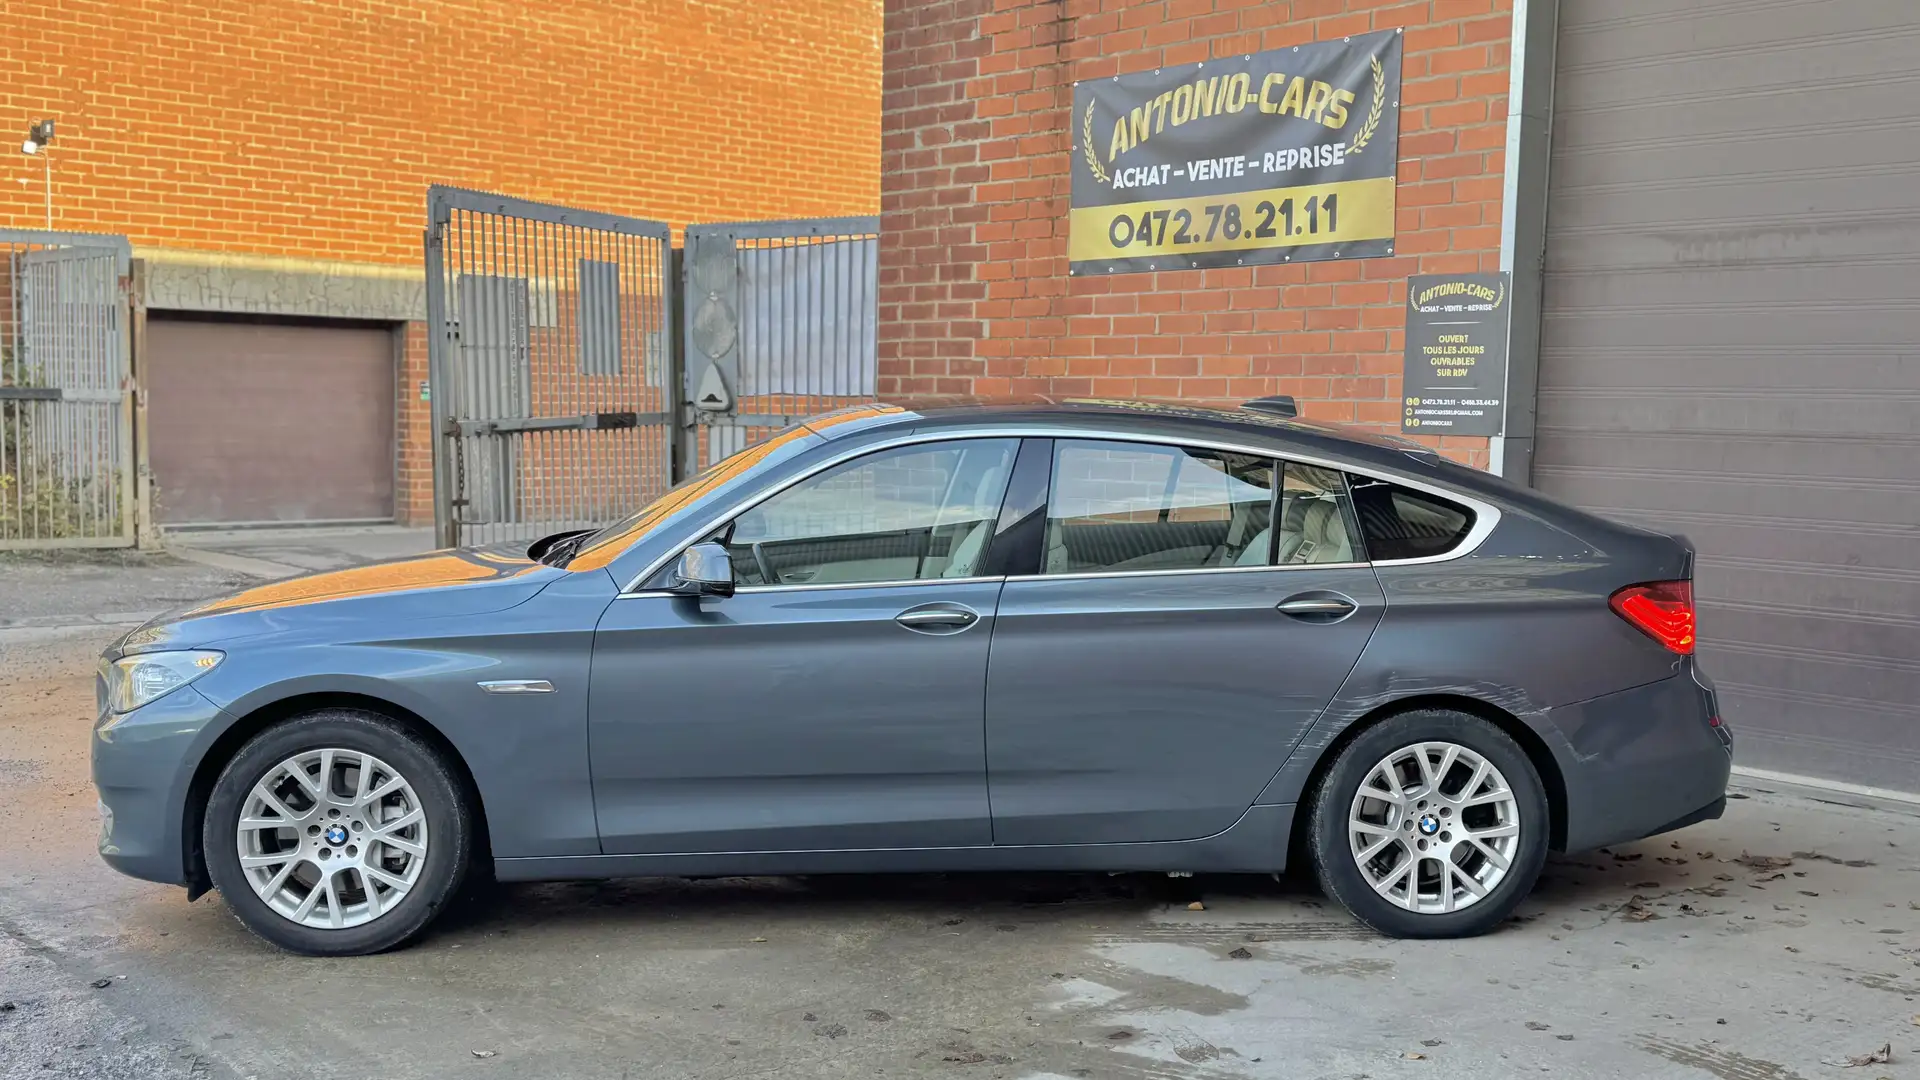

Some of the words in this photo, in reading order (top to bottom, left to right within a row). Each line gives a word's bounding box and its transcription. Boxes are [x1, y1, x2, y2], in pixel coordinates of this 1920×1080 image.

[1109, 72, 1355, 163] ANTONIO-CARS
[1112, 164, 1171, 189] ACHAT
[1187, 155, 1245, 182] VENTE
[1263, 142, 1346, 173] REPRISE
[1108, 193, 1338, 248] 0472.78.21.11
[1419, 282, 1496, 305] ANTONIO-CARS
[1420, 305, 1440, 313] ACHAT
[1444, 304, 1463, 312] VENTE
[1467, 303, 1493, 312] REPRISE
[1438, 334, 1469, 343] OUVERT
[1422, 346, 1442, 355] TOUS
[1443, 346, 1457, 354] LES
[1457, 345, 1485, 354] JOURS
[1430, 357, 1475, 366] OUVRABLES
[1436, 368, 1452, 377] SUR
[1452, 368, 1468, 377] RDV
